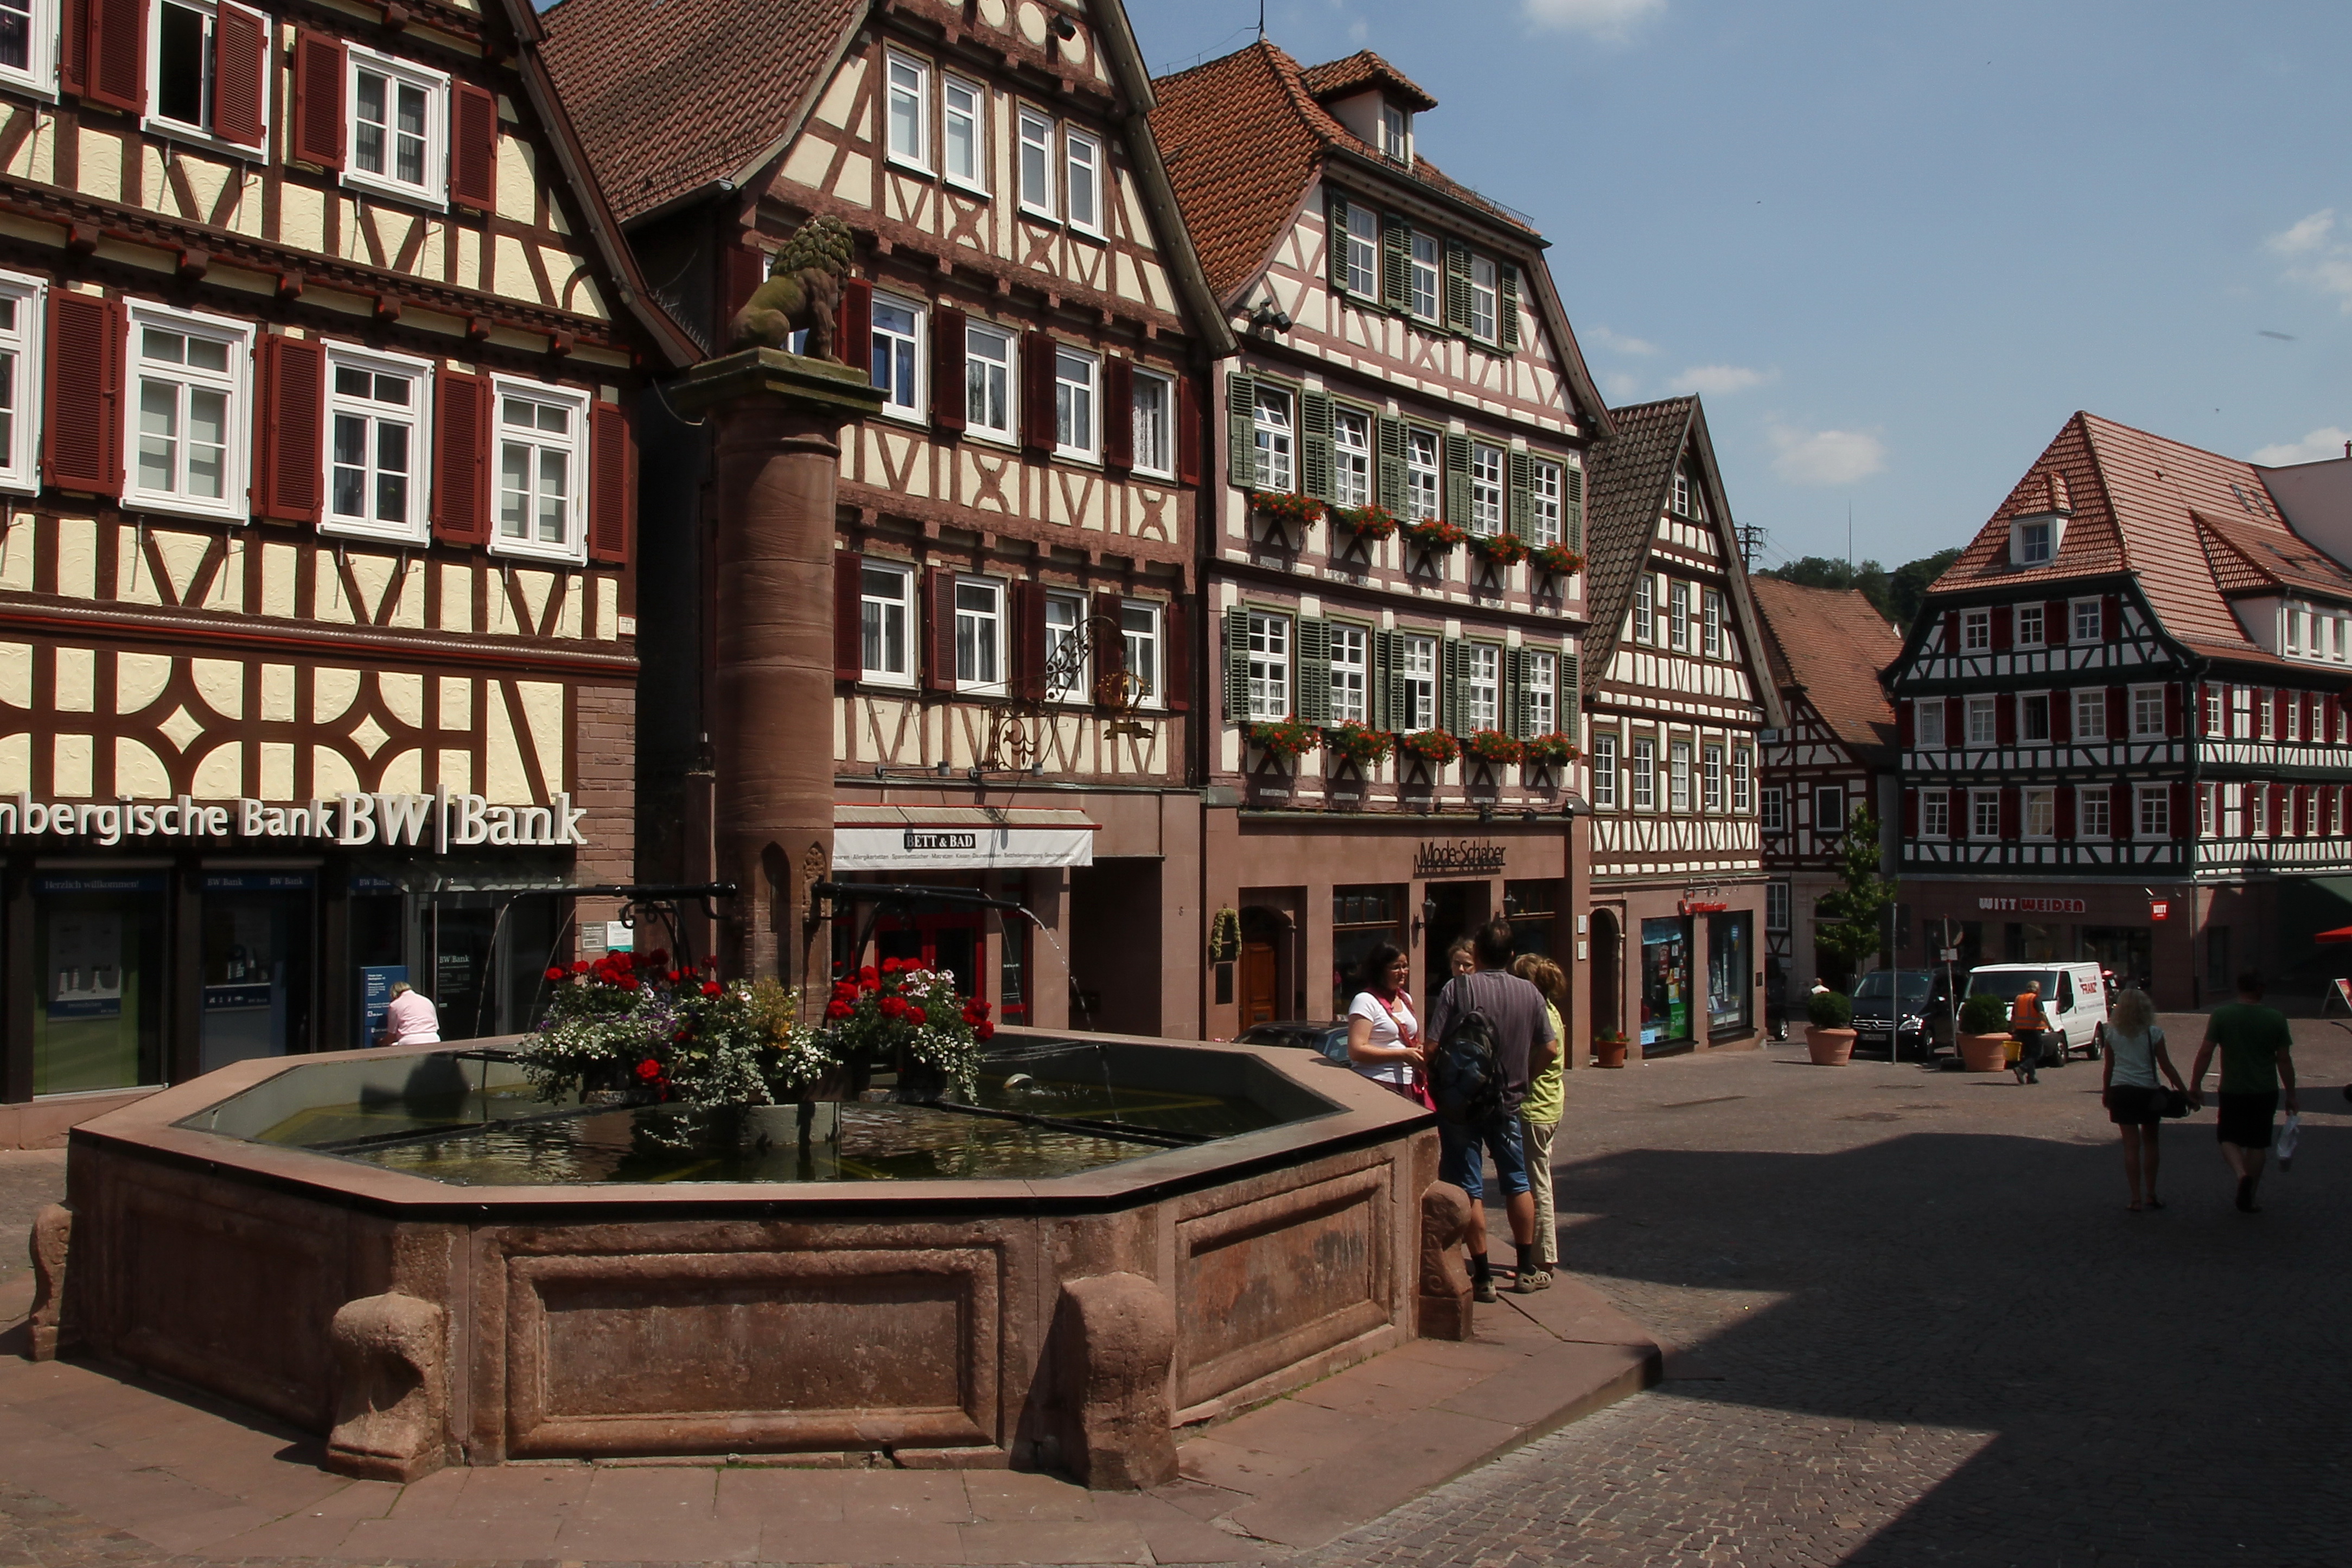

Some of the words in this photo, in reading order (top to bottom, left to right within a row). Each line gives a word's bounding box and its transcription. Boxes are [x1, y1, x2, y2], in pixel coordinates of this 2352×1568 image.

[238, 798, 334, 838] Bank
[907, 834, 937, 847] BETT
[939, 837, 948, 847] &
[949, 834, 973, 847] BAD
[1420, 840, 1506, 866] Mode-Schaber
[44, 880, 81, 889] Herzlich
[83, 879, 139, 889] willkommen!
[207, 878, 220, 886] BW
[223, 877, 243, 885] Bank
[270, 877, 282, 885] BW
[285, 877, 303, 885] Bank
[1979, 897, 2017, 910] WITT
[2020, 897, 2086, 913] WEIDEN
[452, 954, 470, 963] Bank
